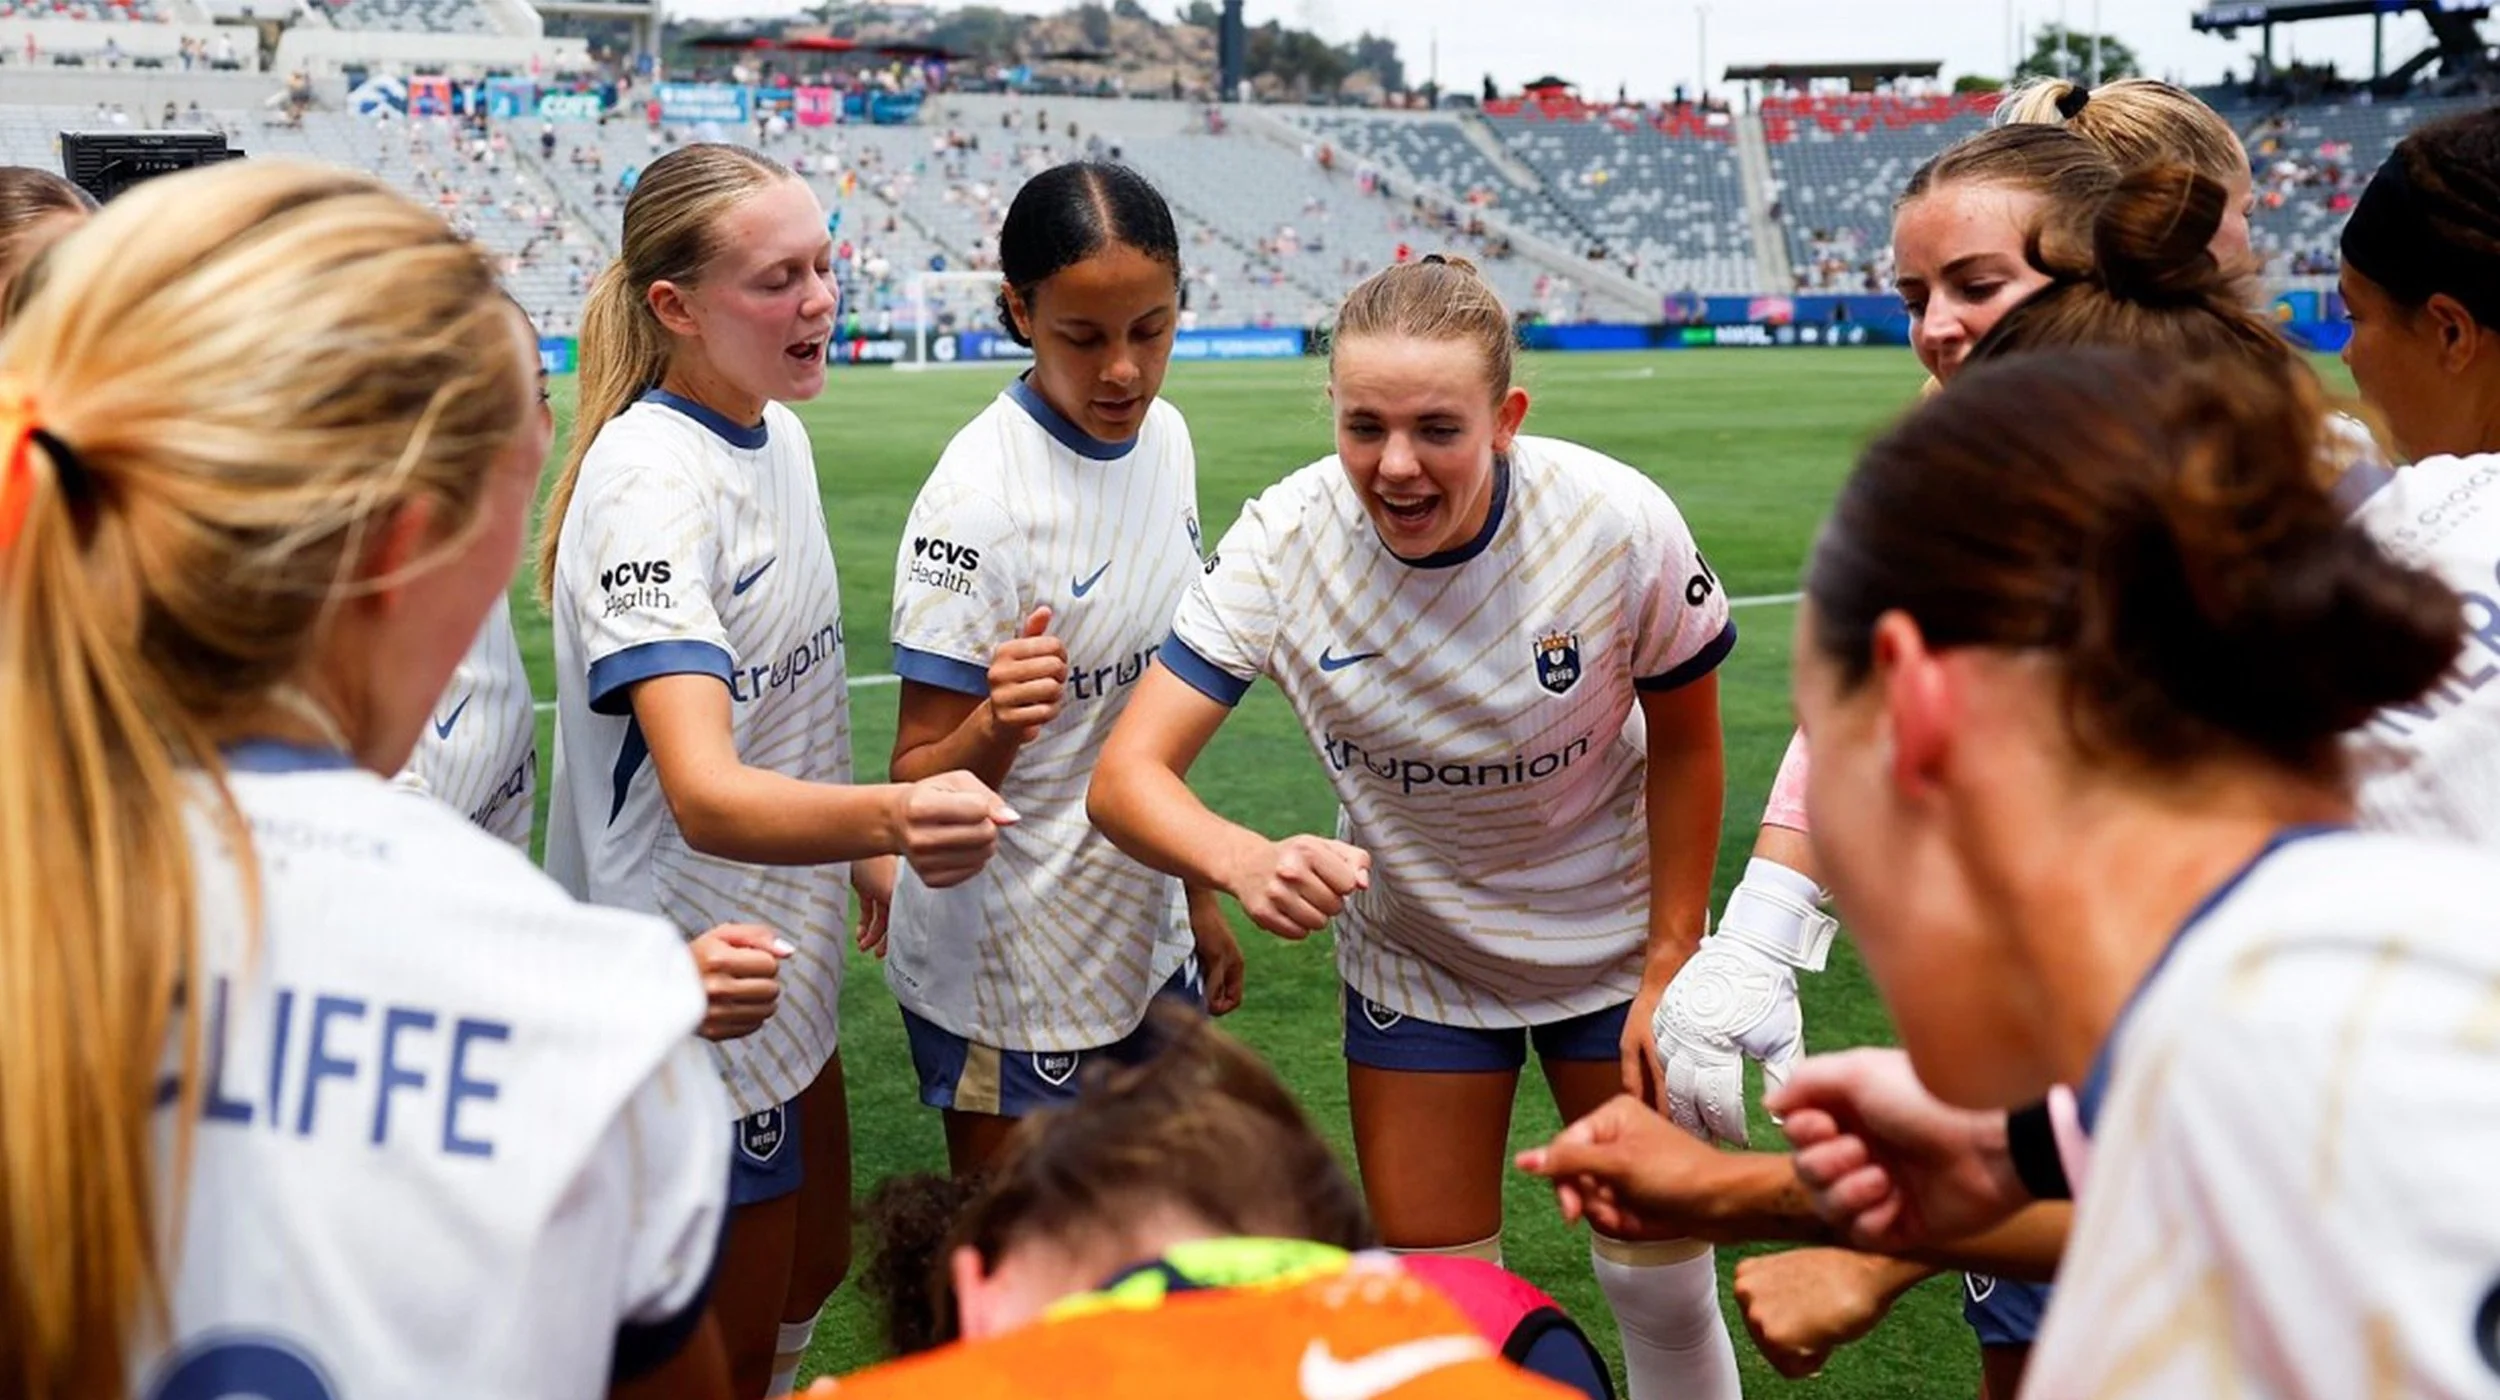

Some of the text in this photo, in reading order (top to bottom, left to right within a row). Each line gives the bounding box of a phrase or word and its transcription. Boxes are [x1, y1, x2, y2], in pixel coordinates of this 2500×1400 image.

[928, 538, 980, 571] CVS
[615, 560, 671, 587] CVS
[1325, 732, 1590, 795] trupanion
